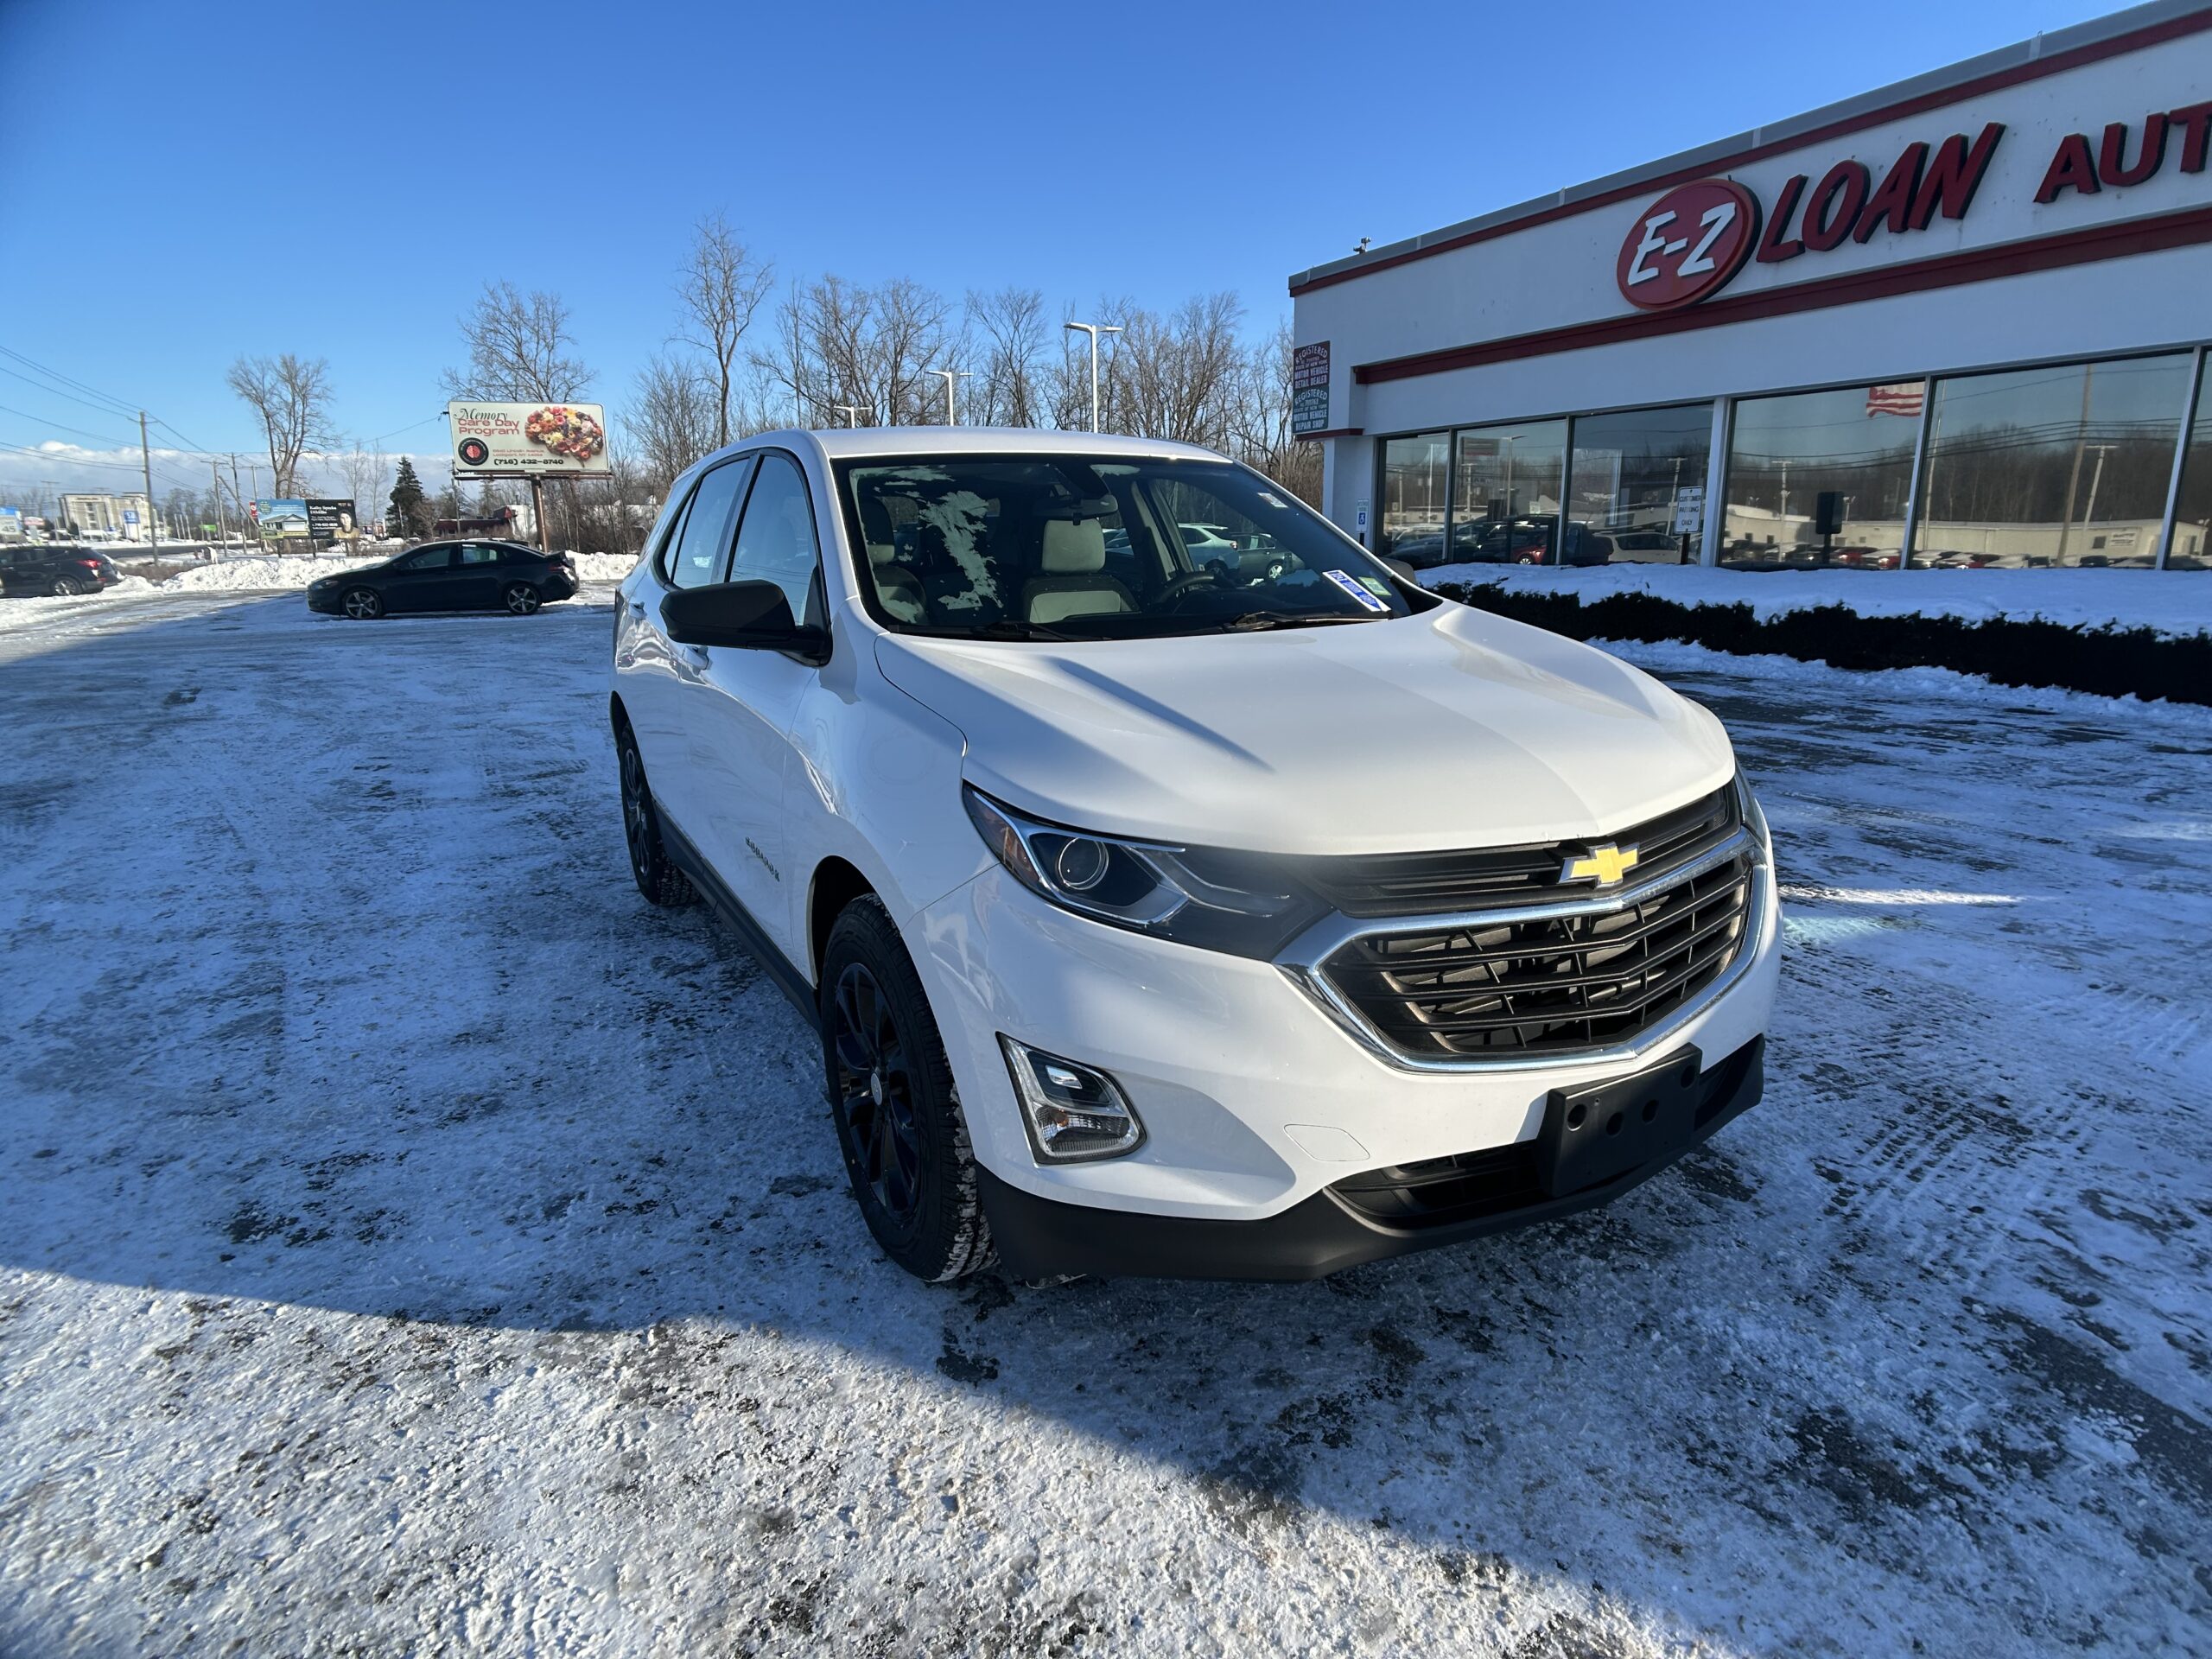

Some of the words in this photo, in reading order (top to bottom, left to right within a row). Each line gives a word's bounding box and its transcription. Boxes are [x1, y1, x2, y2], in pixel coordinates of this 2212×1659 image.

[1628, 202, 1736, 285] E-Z
[1756, 122, 2006, 263] LOAN
[2033, 100, 2212, 204] AUT
[1295, 346, 1328, 365] REGISTERED
[1310, 365, 1329, 377] VEHICLE
[1295, 378, 1310, 389] RETAIL
[1310, 374, 1327, 386] DEALER
[1294, 388, 1328, 406] REGISTERED
[453, 408, 508, 422] Memory
[1309, 409, 1327, 420] VEHICLE
[495, 419, 519, 429] Day
[1296, 421, 1312, 431] REPAIR
[1312, 419, 1325, 429] SHOP
[459, 426, 519, 437] Program
